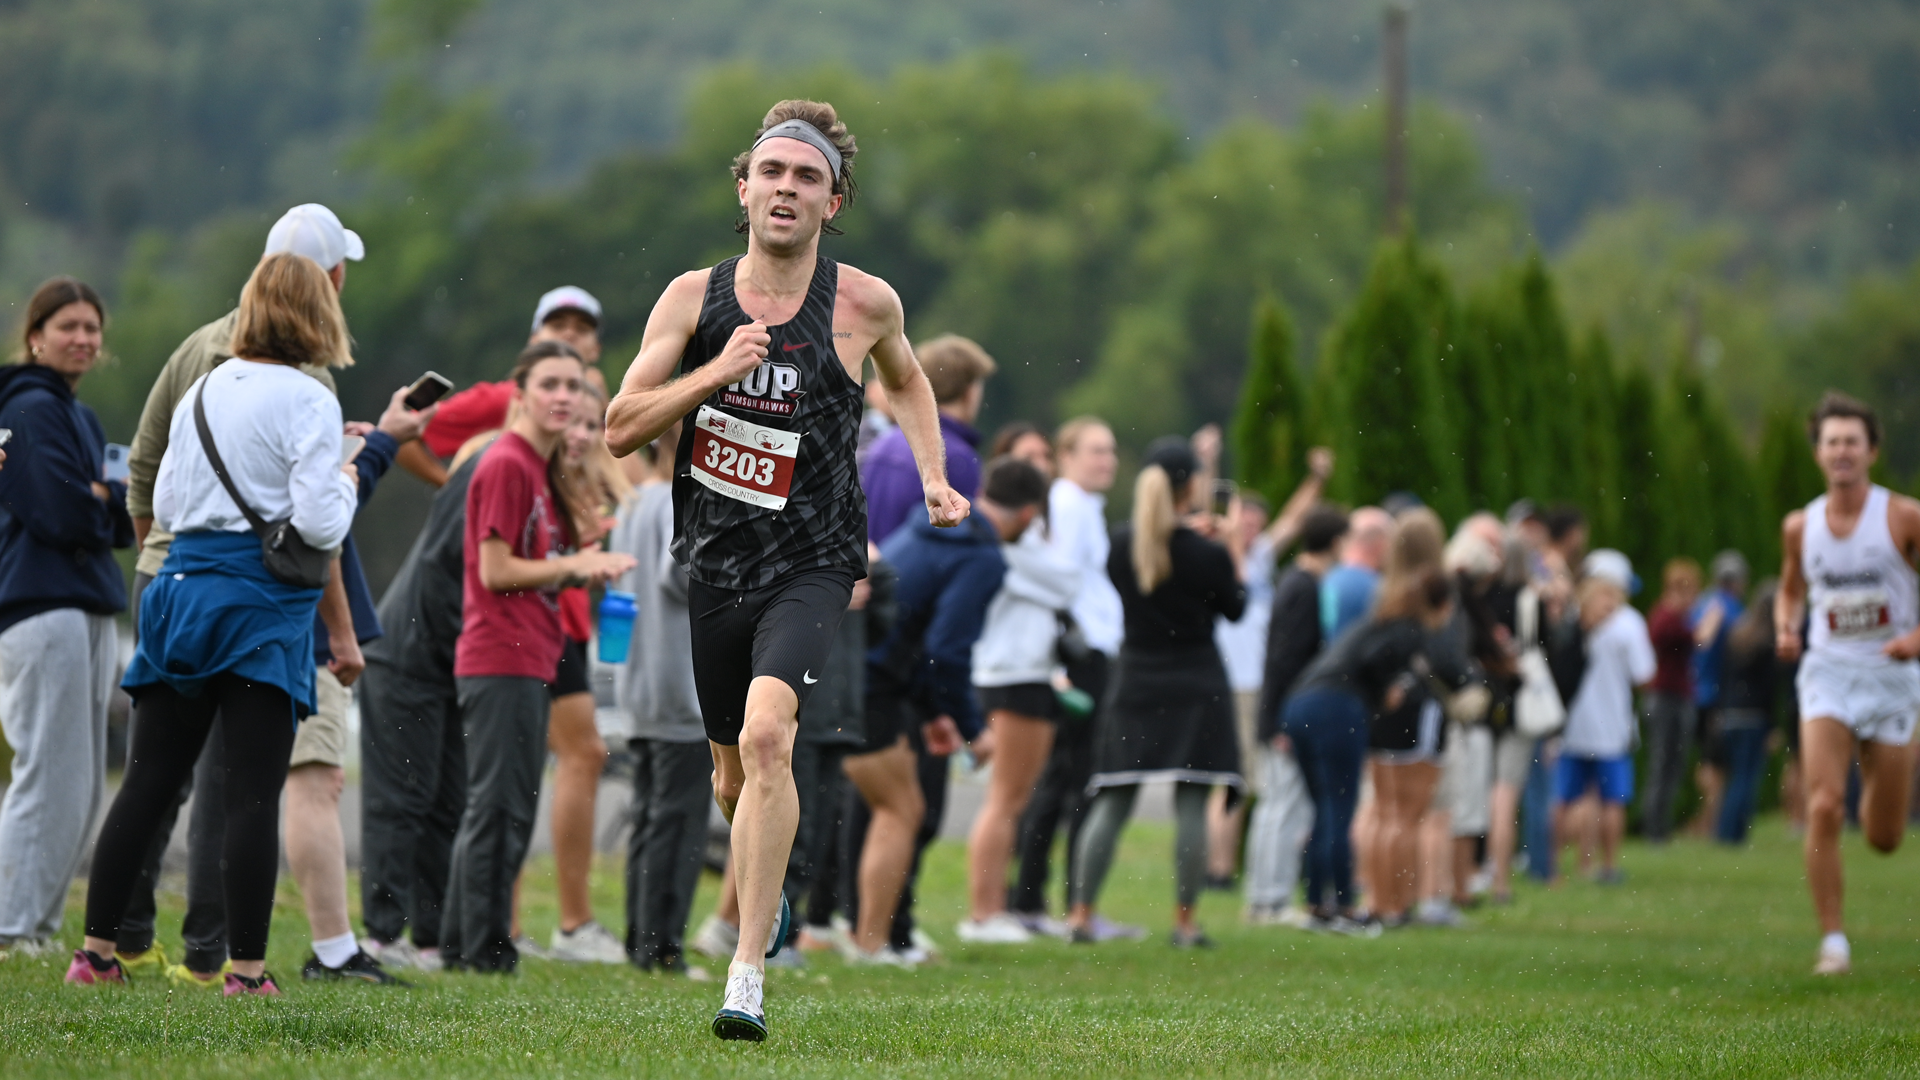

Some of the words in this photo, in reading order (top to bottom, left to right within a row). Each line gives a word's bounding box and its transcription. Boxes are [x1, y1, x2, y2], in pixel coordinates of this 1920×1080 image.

[729, 362, 798, 400] UP
[724, 393, 757, 408] CRIMSON
[760, 401, 790, 414] HAWKS
[704, 439, 776, 486] 3203
[708, 478, 728, 492] CROSS
[727, 486, 760, 502] COUNTRY
